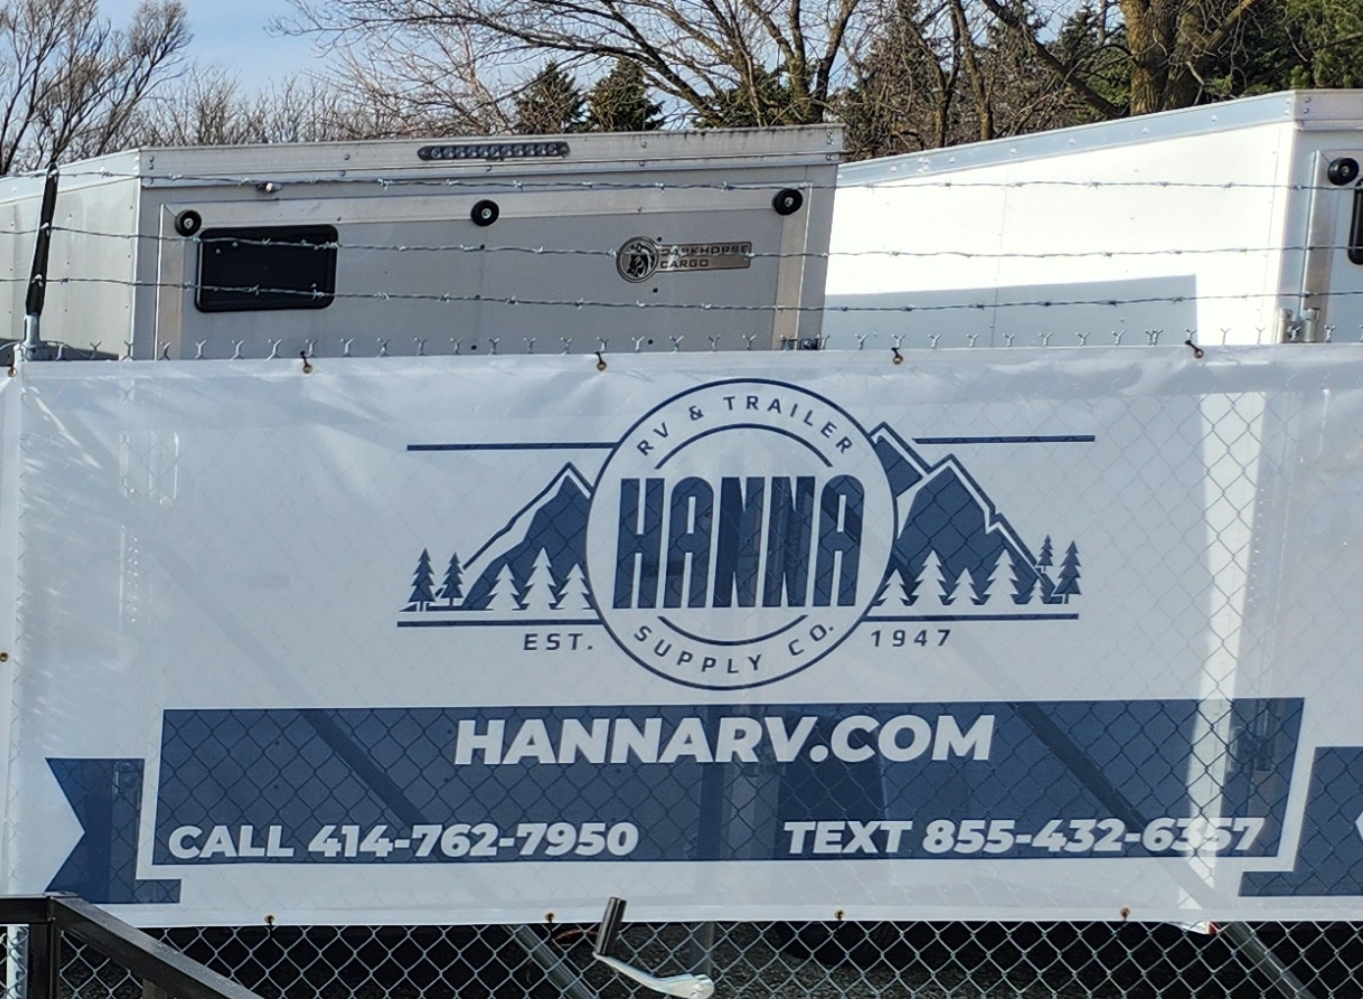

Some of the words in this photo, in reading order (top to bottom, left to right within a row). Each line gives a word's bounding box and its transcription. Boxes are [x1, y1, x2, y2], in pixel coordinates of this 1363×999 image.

[660, 259, 709, 269] CARGO
[636, 421, 670, 456] RV
[688, 405, 704, 421] &
[723, 395, 854, 453] TRAILER
[612, 474, 865, 609] HANNA
[524, 633, 595, 652] EST.
[633, 625, 762, 674] SUPPLY
[788, 624, 835, 656] CO.
[870, 629, 953, 648] 1947
[454, 714, 996, 765] HANNARV.COM
[168, 824, 294, 859] CALL
[308, 822, 639, 858] 414-762-7950
[783, 820, 913, 854] TEXT
[922, 818, 1265, 853] 855-432-6357
